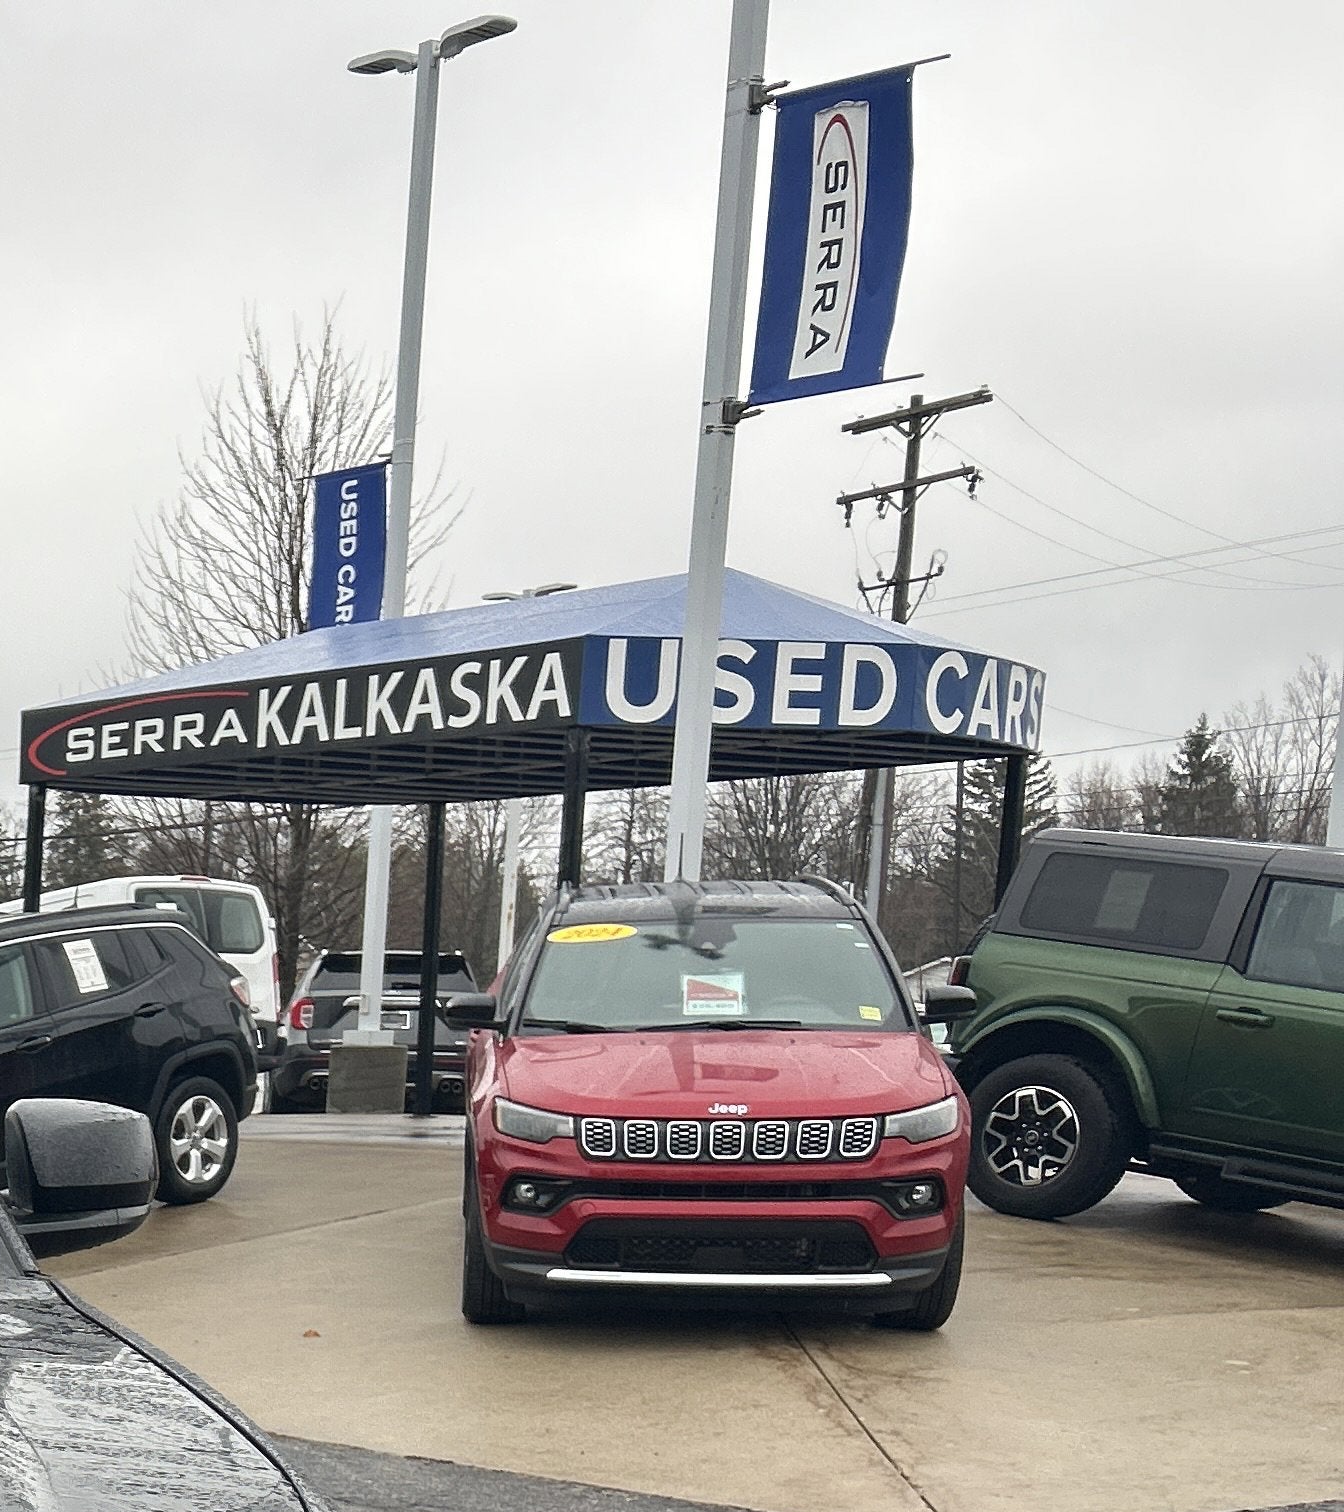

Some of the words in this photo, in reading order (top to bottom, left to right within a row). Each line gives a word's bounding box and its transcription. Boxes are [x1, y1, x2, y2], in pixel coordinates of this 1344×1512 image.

[804, 160, 848, 360] SERRA
[339, 479, 359, 558] USED
[334, 564, 356, 626] CAR
[65, 708, 249, 763] SERRA
[255, 652, 572, 749] KALKASKA
[605, 638, 897, 726] USED
[925, 650, 1042, 750] CARS
[708, 1102, 748, 1116] Jeep
